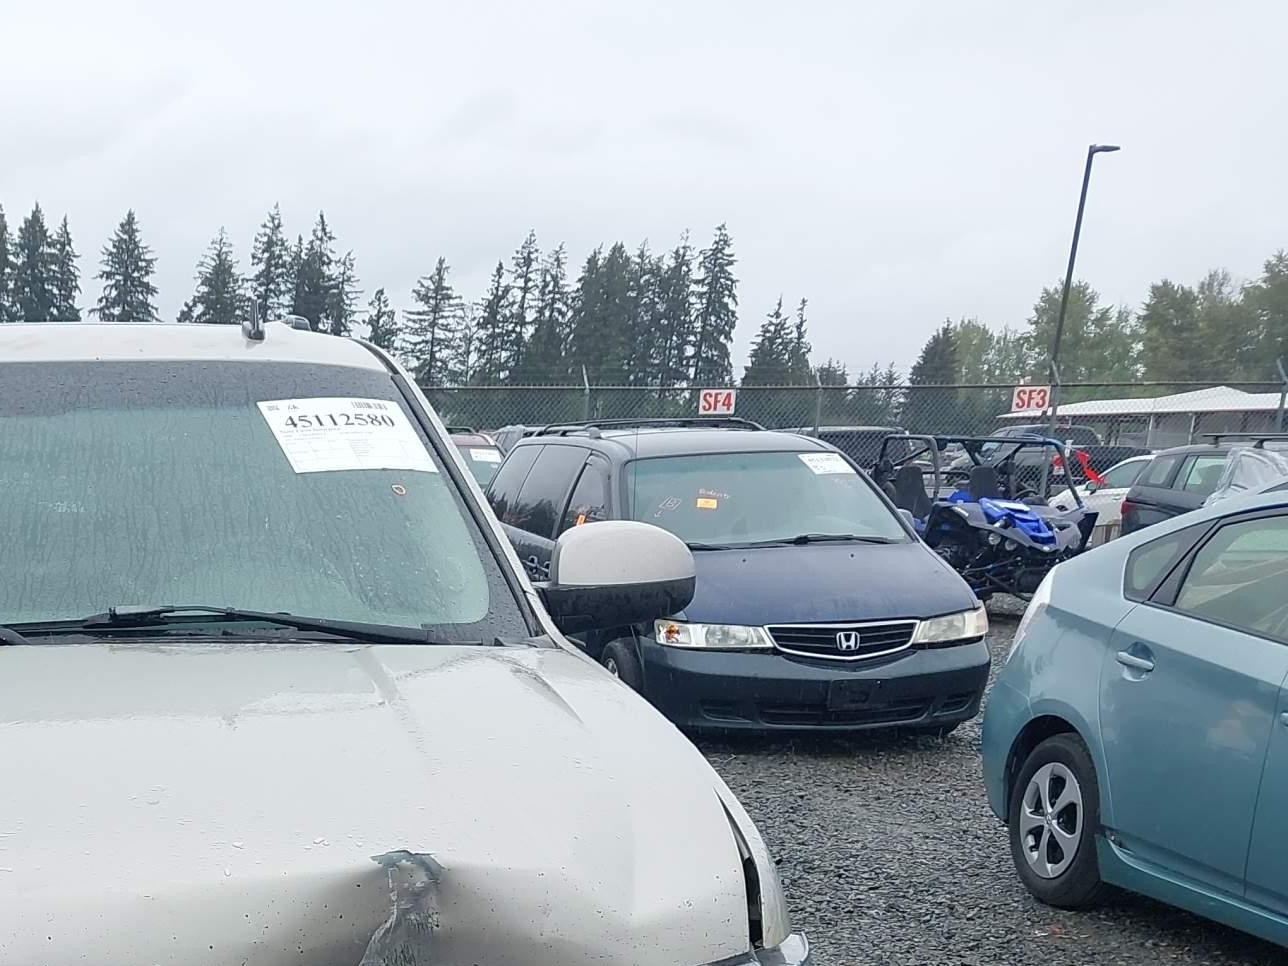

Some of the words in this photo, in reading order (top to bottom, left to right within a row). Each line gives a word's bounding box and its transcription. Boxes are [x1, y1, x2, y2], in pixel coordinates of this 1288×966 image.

[702, 392, 733, 411] SF4
[1015, 388, 1048, 409] SF3
[285, 413, 395, 428] 45112580
